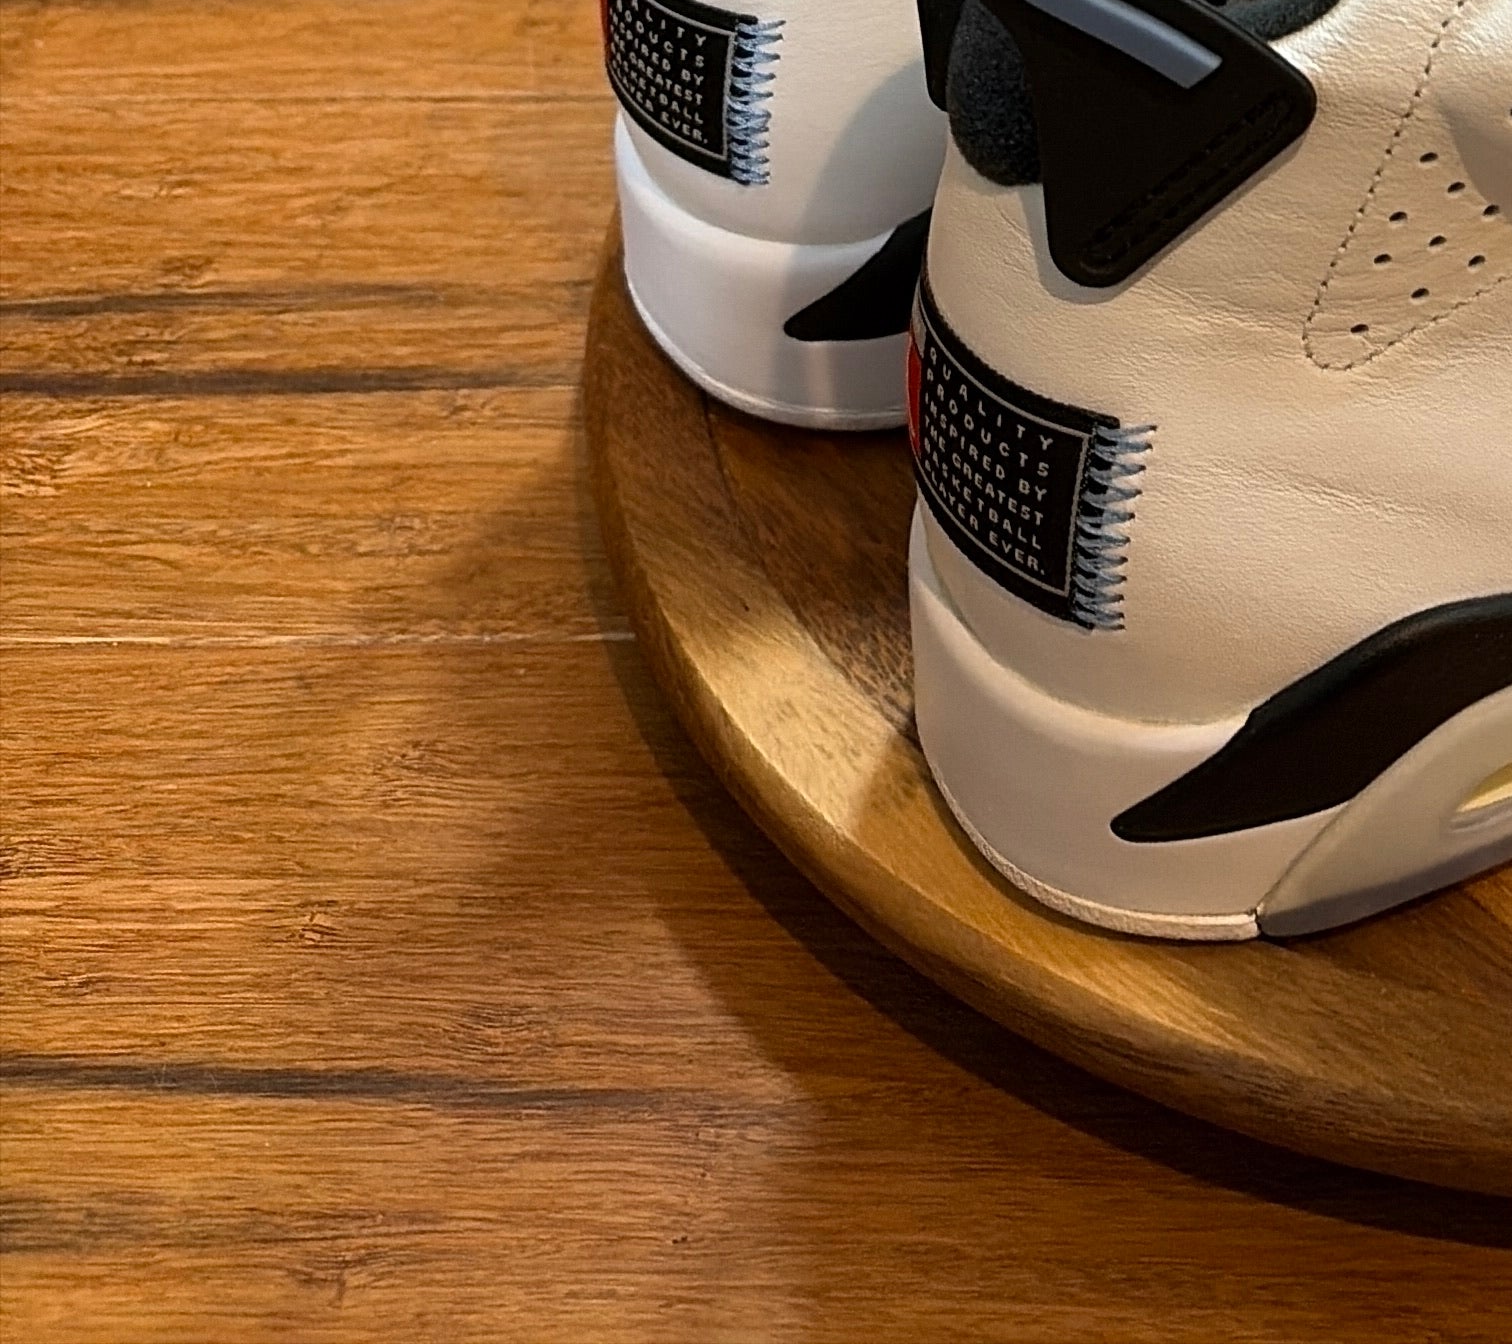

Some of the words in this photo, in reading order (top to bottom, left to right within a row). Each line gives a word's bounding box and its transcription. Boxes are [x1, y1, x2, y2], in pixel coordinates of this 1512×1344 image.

[629, 50, 704, 105] GREATEST
[924, 392, 1006, 480] INSPIRED
[1018, 479, 1048, 503] BY
[926, 368, 1050, 478] PRODUCTS
[929, 346, 1054, 452] QUALITY
[924, 440, 1042, 550] BASKETBALL
[924, 459, 980, 532] PLAYER
[989, 531, 1046, 576] EVER.
[952, 454, 1044, 526] GREATEST
